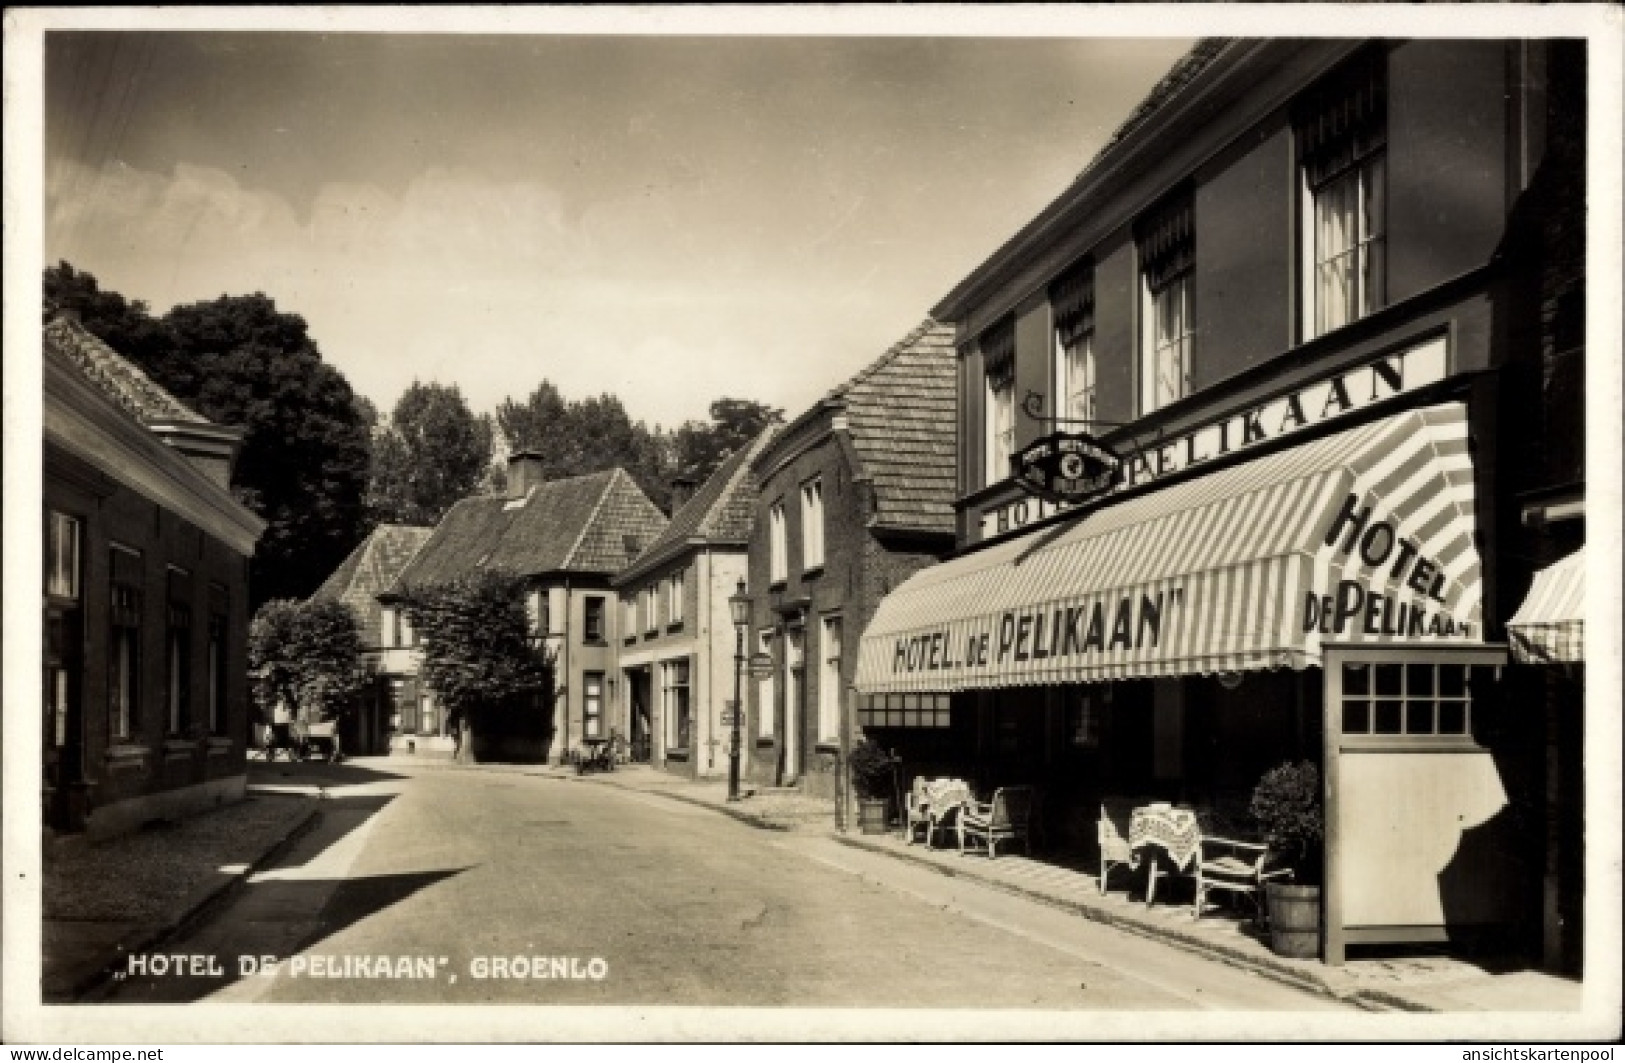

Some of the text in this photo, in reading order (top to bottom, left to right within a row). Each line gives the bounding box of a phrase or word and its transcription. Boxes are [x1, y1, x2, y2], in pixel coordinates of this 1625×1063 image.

[1127, 353, 1404, 481] PELIKAAN
[1324, 492, 1447, 603] HOTEL
[1302, 580, 1470, 638] DE PELIKAAN
